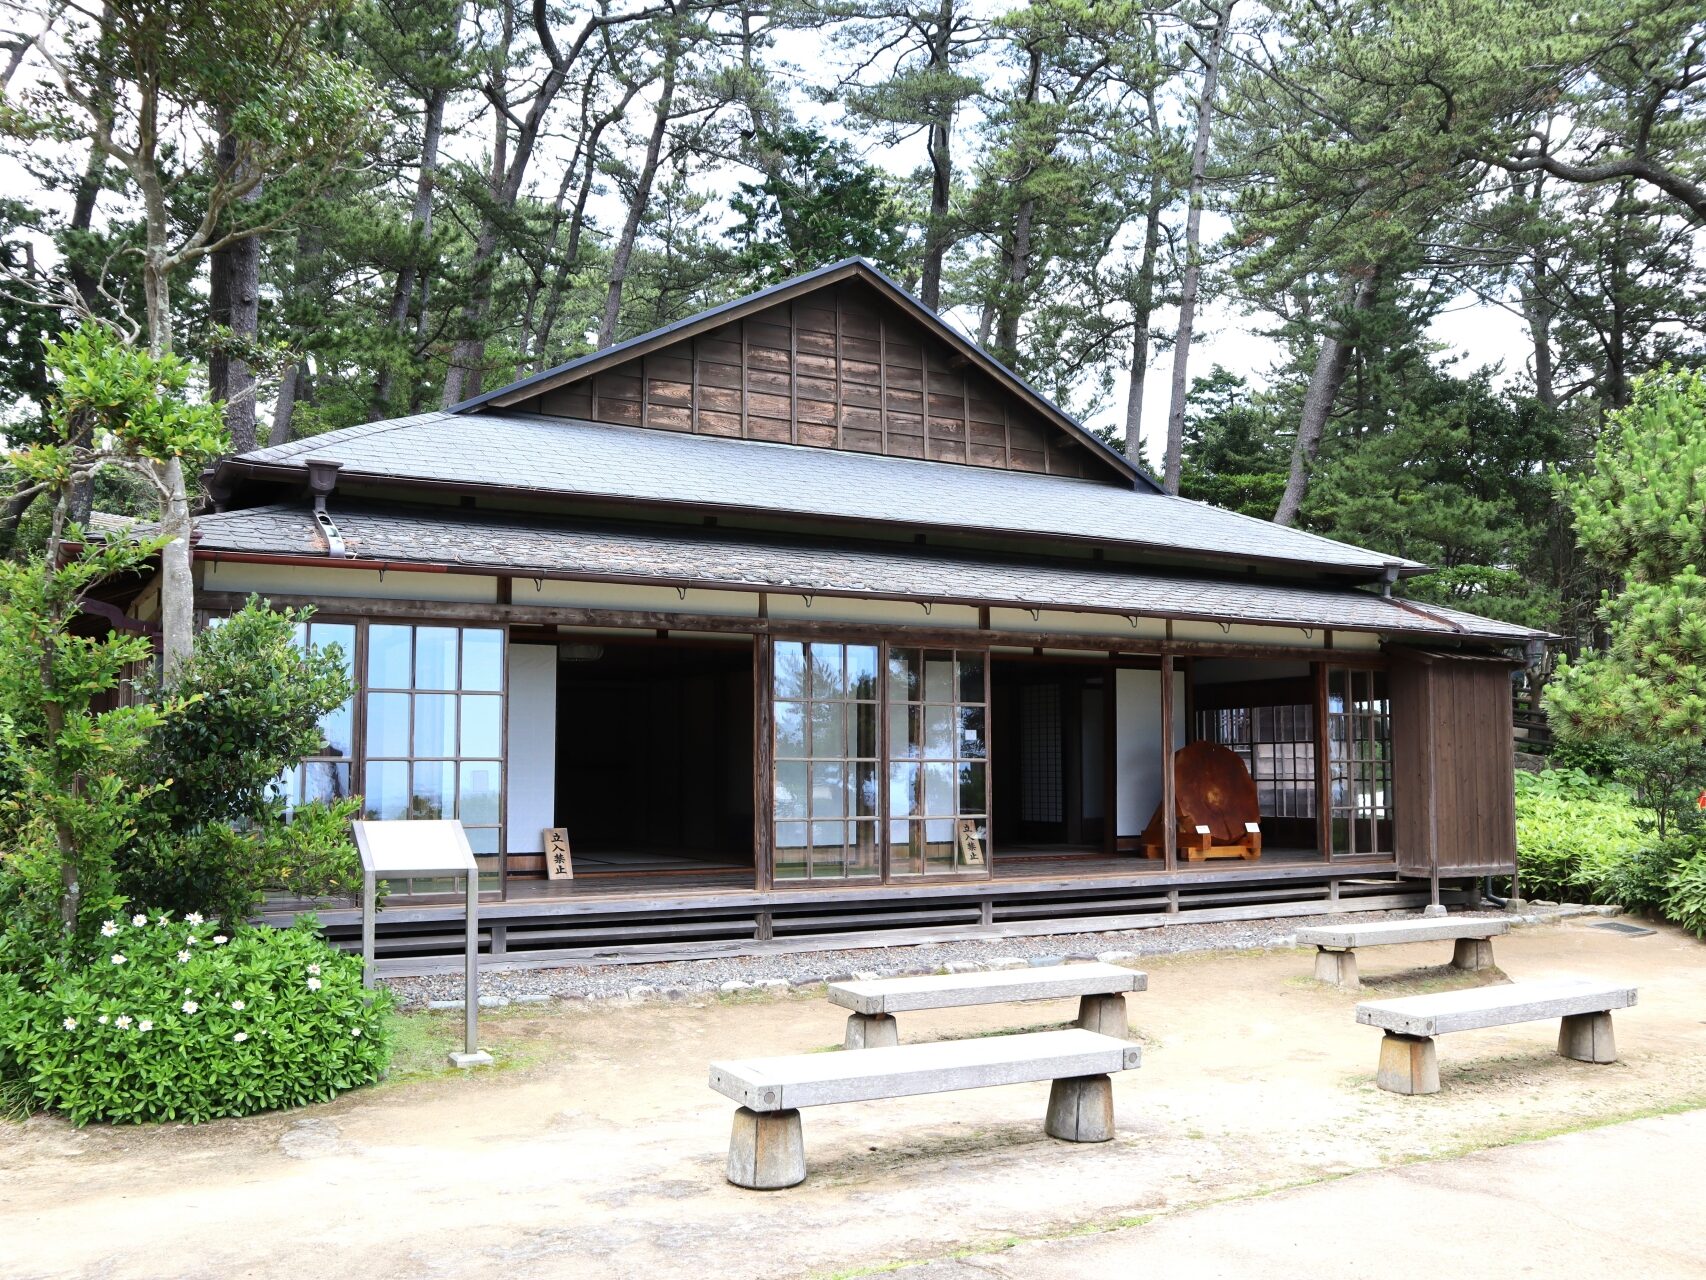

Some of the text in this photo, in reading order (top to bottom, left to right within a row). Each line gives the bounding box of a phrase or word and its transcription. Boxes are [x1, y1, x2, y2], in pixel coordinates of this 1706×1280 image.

[551, 832, 567, 875] 立入禁止
[963, 823, 979, 860] 立入禁止
